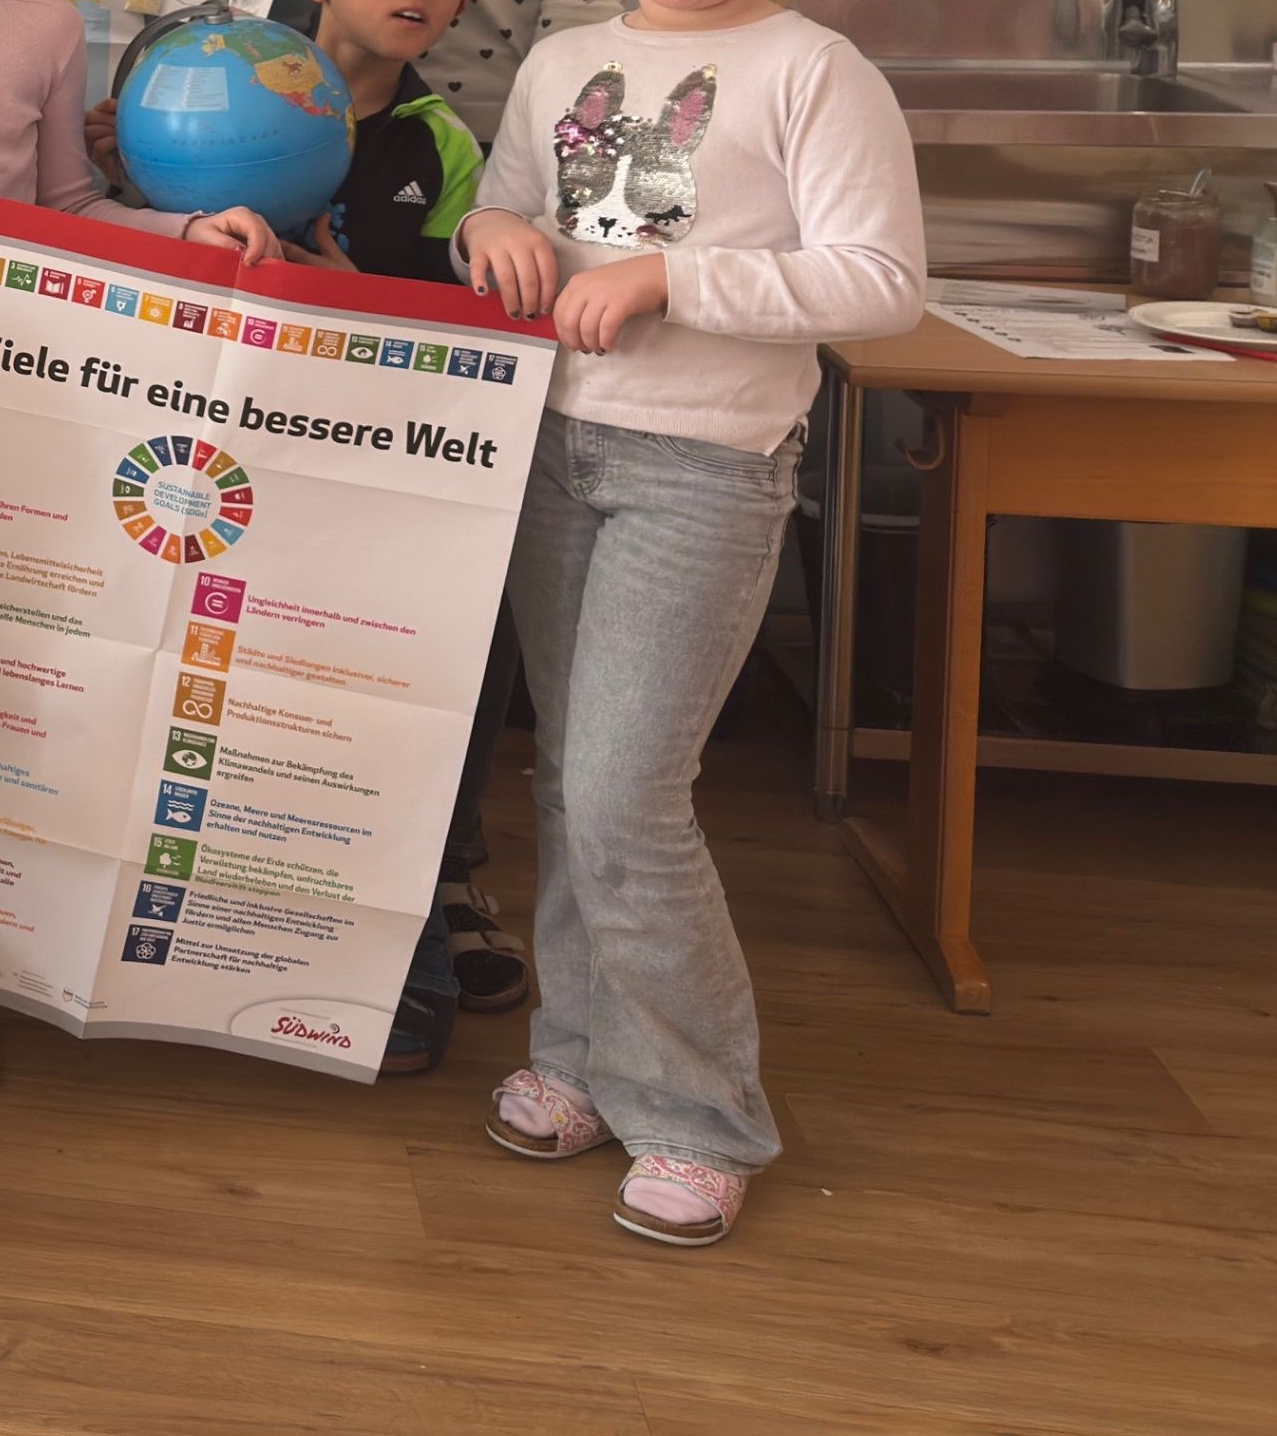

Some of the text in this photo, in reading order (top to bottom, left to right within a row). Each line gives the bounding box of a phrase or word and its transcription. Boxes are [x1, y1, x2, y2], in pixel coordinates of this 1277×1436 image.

[393, 195, 427, 205] adidas
[80, 356, 139, 397] für
[146, 380, 229, 423] eine
[239, 396, 393, 450] bessere
[406, 421, 496, 468] Welt
[20, 504, 51, 517] Formen
[51, 512, 68, 521] und
[14, 615, 55, 630] Menschen
[55, 623, 64, 632] in
[64, 625, 91, 637] jedem
[51, 614, 67, 622] und
[67, 616, 82, 625] das
[245, 605, 325, 628] Ländern verringern
[247, 594, 416, 635] Ungleichheit innerhalb und zwischen den
[0, 658, 16, 666] und
[16, 659, 66, 678] hochwertige
[1, 667, 54, 686] lebenslanges
[55, 679, 84, 692] Lernen
[226, 709, 352, 742] Produktionsstrukturen sichern
[227, 697, 332, 727] Nachhaltige Konsum- und
[218, 757, 379, 796] Klimawandels und seinen Auswirkungen
[219, 745, 353, 780] Maßnahmen zur Bekämpfung des
[206, 821, 287, 842] erhalten und nutzen
[207, 809, 351, 845] Sinne der nachhaltigen Entwicklung
[243, 804, 268, 817] Meere
[269, 812, 286, 820] und
[286, 813, 360, 834] Meeresressourcen
[361, 827, 372, 836] im
[200, 843, 339, 877] Ökosysteme der Erde schützen, die
[196, 865, 355, 902] Land wiederbeleben und den Verlust der
[188, 890, 228, 903] Friedliche
[246, 901, 282, 913] inklusive
[283, 907, 343, 923] Gesellschaften
[343, 918, 354, 926] im
[173, 945, 287, 972] Partnerschaft für nachhaltige
[175, 937, 199, 947] Mittel
[214, 943, 259, 959] Umsetzung
[273, 955, 309, 966] globalen
[270, 1016, 351, 1048] SÜDWIND
